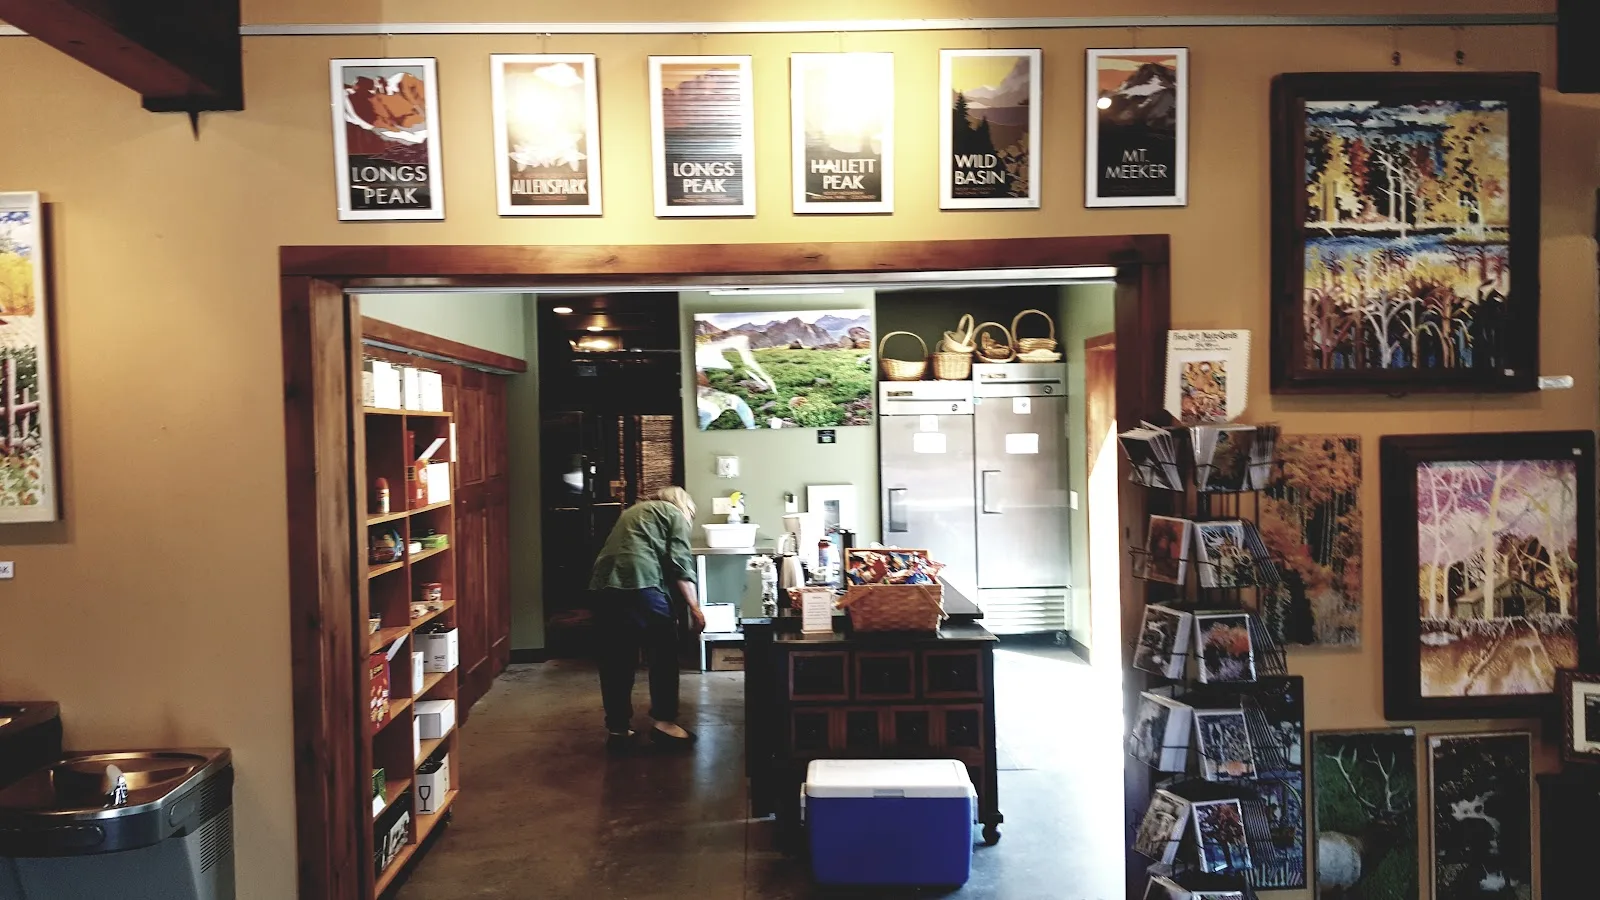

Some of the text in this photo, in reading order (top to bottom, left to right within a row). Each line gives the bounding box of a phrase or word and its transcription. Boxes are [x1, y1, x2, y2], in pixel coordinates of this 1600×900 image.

[954, 154, 998, 169] WILD
[1122, 148, 1151, 163] MT.
[672, 162, 736, 177] LONGS
[811, 158, 877, 174] HALLETT
[1105, 164, 1168, 179] MEEKER
[351, 166, 428, 182] LONGS
[954, 170, 1006, 185] BASIN
[511, 179, 588, 195] ALLENSPARK
[682, 179, 728, 193] PEAK
[822, 175, 866, 190] PEAK
[363, 187, 419, 204] PEAK
